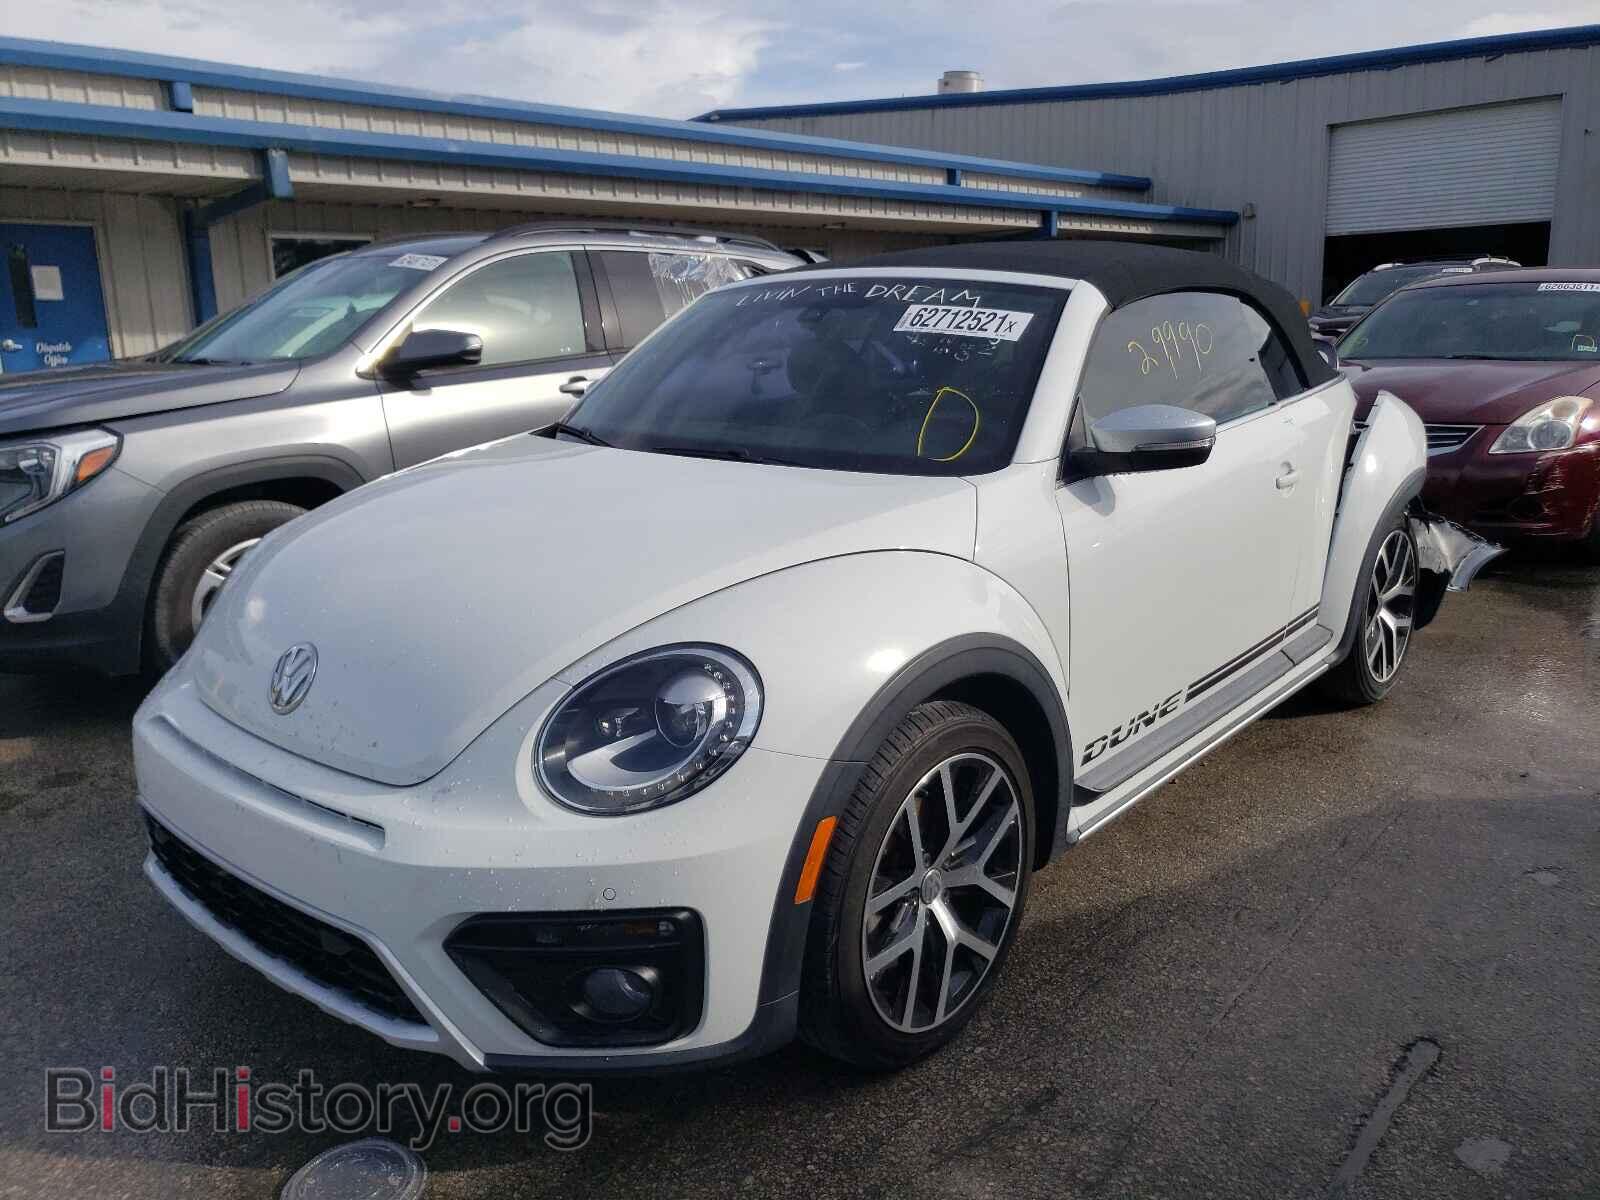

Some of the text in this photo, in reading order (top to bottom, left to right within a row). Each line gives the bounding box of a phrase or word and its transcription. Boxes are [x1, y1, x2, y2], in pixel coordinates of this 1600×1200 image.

[816, 283, 857, 297] THE
[864, 284, 981, 309] DREAM
[1127, 320, 1213, 380] 29990
[917, 386, 980, 461] D
[1080, 688, 1184, 768] DUNE
